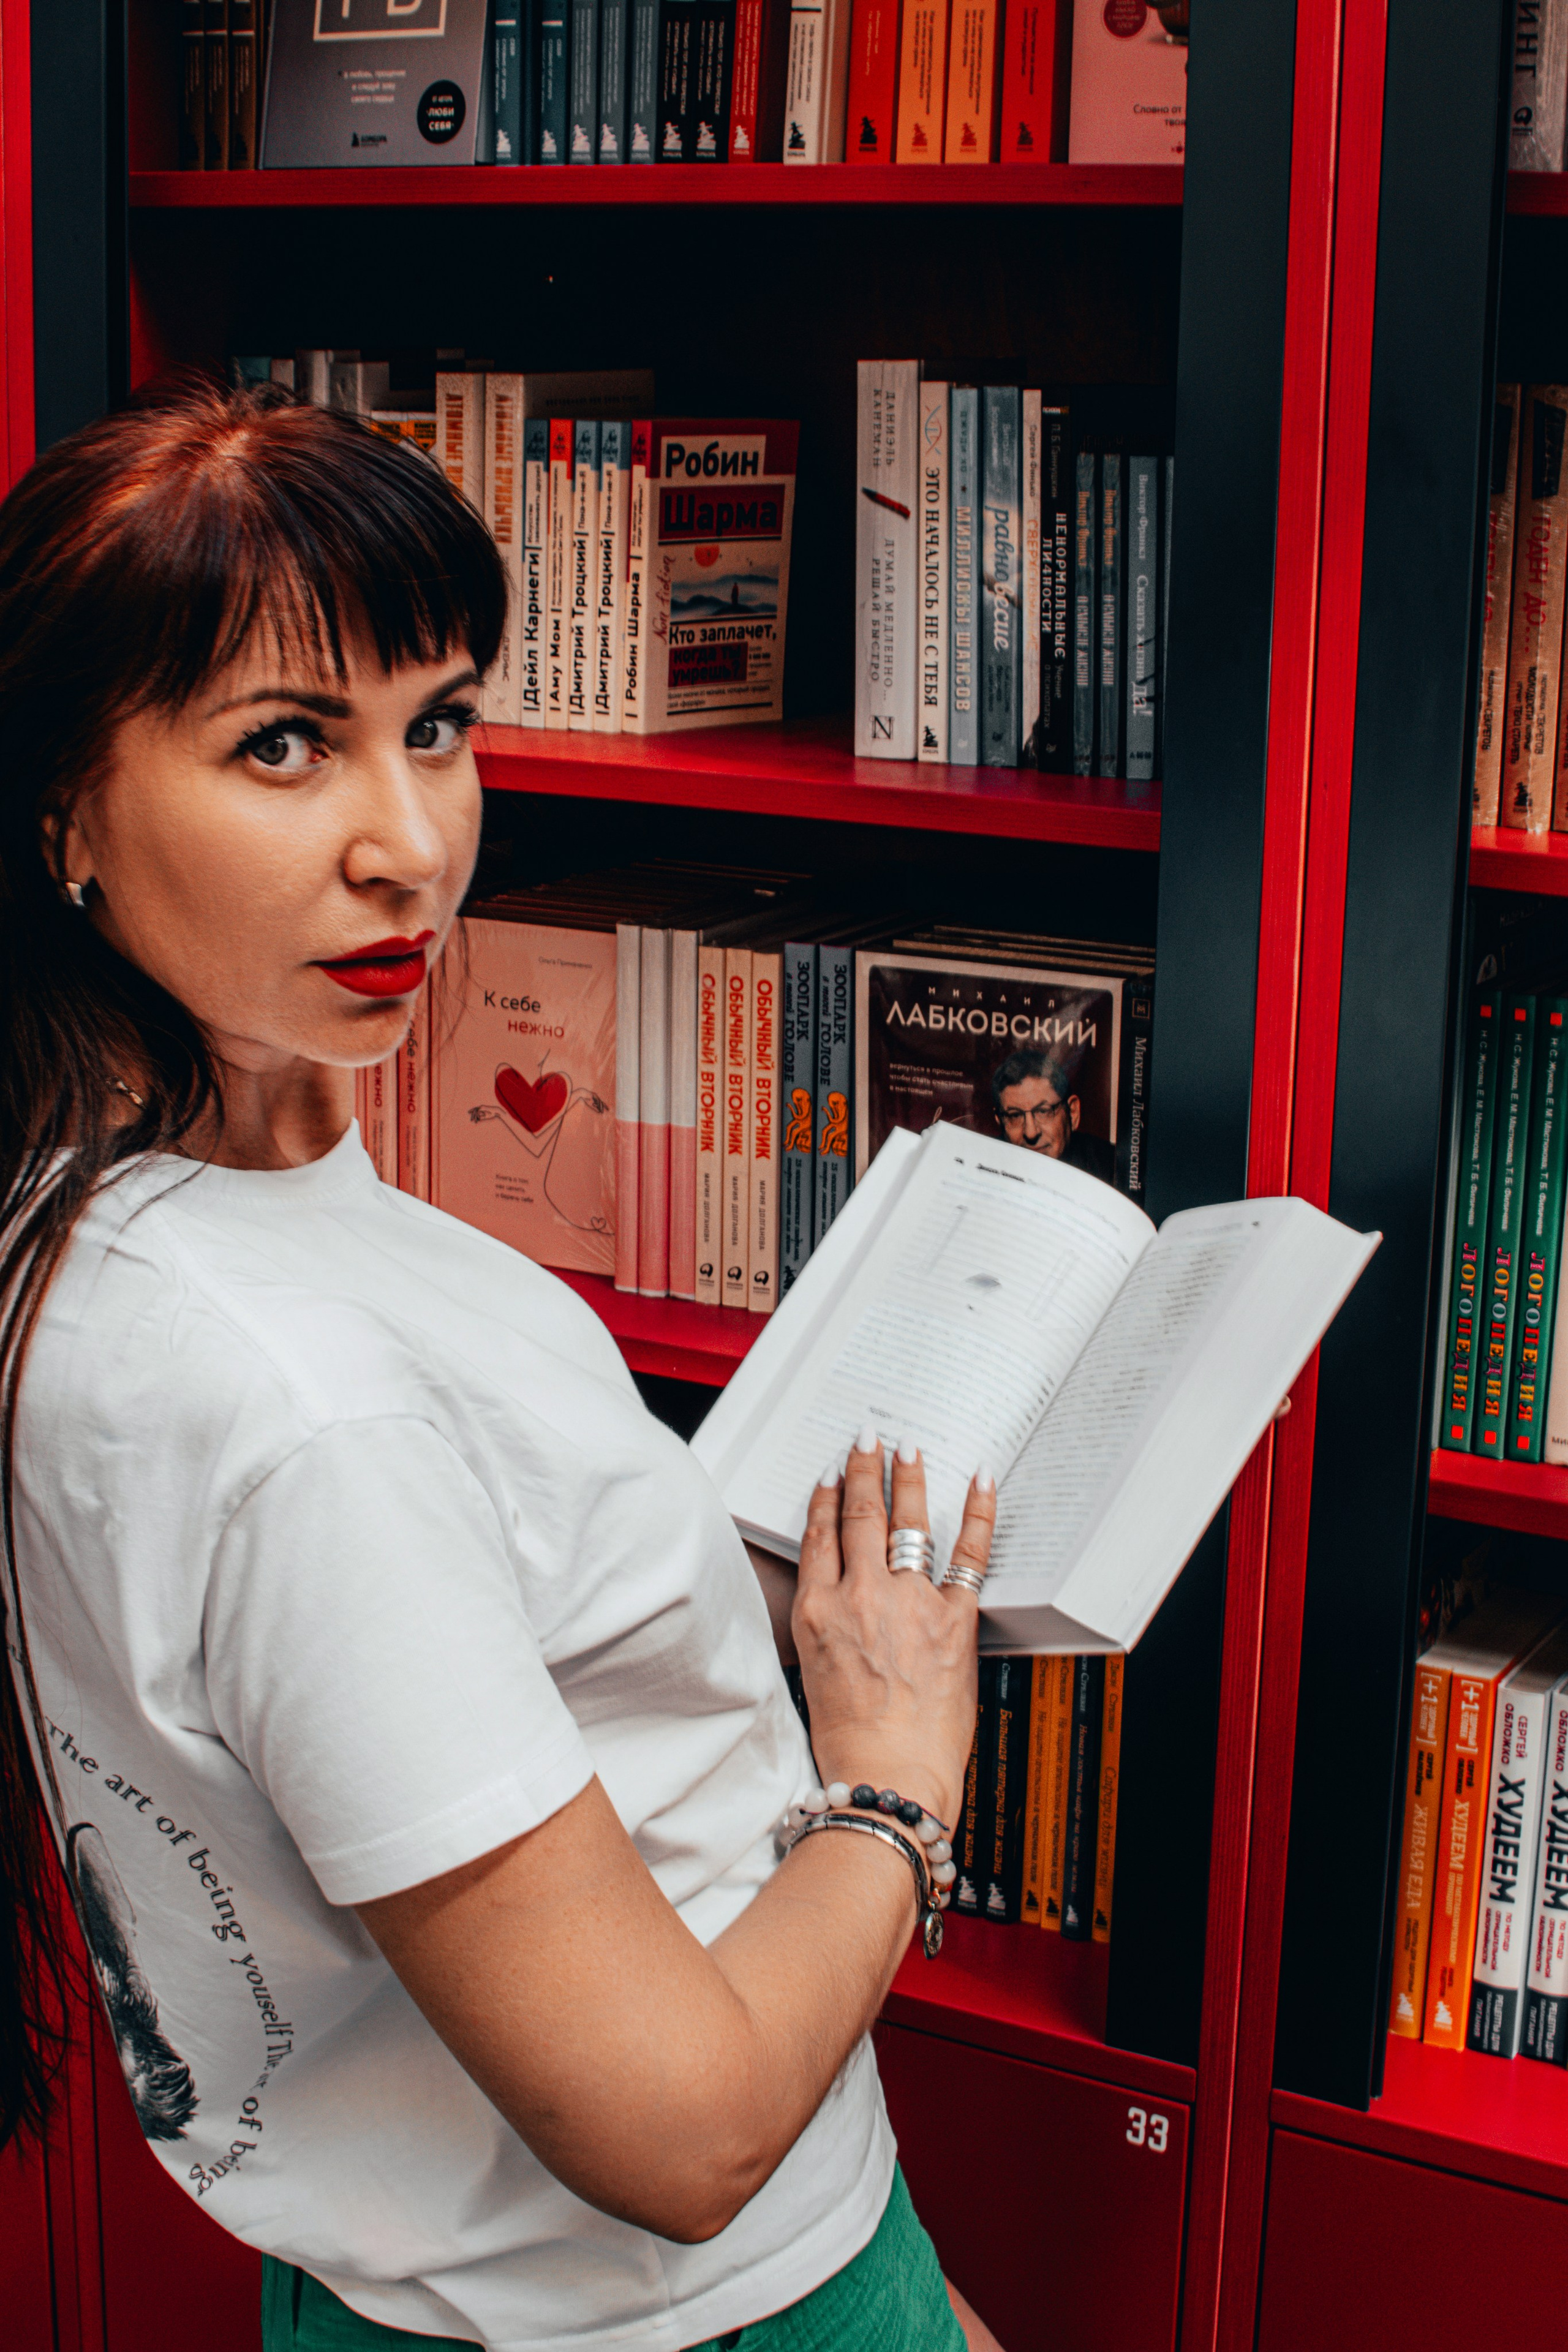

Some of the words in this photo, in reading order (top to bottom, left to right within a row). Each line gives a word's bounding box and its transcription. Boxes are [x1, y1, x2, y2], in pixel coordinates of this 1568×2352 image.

[873, 388, 882, 468] КАНЕМАН
[886, 391, 895, 466] ДАНИЭЛЬ
[665, 442, 759, 478] Робин
[925, 466, 940, 503] ЭТО
[663, 494, 777, 536] Шарма
[1137, 474, 1148, 514] Виктор
[884, 538, 895, 595] ДУМАЙ
[924, 509, 940, 609] НАЧАЛОСЬ
[955, 506, 972, 624] МИЛЛИОНЫ
[1137, 516, 1148, 560] Франкл
[1526, 516, 1551, 584] ГОДЕН
[525, 552, 542, 642] Карнеги
[571, 538, 587, 619] Троцкий
[597, 538, 614, 618] Троцкий
[628, 573, 641, 637] Шарма
[871, 558, 882, 612] РЕШАЙ
[984, 505, 1017, 652] равновесие
[1054, 513, 1067, 658] НЕНОРМАЛЬНЫЕ
[1136, 575, 1148, 631] Сказать
[549, 619, 562, 658] Мом
[669, 625, 695, 644] Кто
[700, 624, 777, 642] заплачет,
[674, 647, 717, 664] когда
[722, 645, 742, 659] ты
[871, 619, 880, 682] БЫСТРО
[924, 615, 939, 639] НЕ
[924, 644, 939, 656] С
[524, 649, 541, 704] Дейл
[549, 665, 563, 703] Аму
[570, 625, 586, 709] Дмитрий
[595, 625, 612, 709] Дмитрий
[625, 644, 638, 701] Робин
[673, 660, 741, 686] умрешь?
[924, 661, 939, 707] ТЕБЯ
[955, 631, 972, 712] ШАНСОВ
[484, 989, 496, 1008] К
[500, 995, 541, 1013] себе
[701, 973, 718, 1065] ОБЫЧНЫЙ
[729, 975, 747, 1068] ОБЫЧНЫЙ
[756, 978, 775, 1071] ОБЫЧНЫЙ
[797, 961, 810, 1041] ЗООПАРК
[834, 964, 847, 1044] ЗООПАРК
[886, 1000, 1096, 1048] ЛАБКОВСКИЙ
[928, 986, 1055, 1008] МИХАИЛ
[507, 1019, 565, 1039] нежно
[784, 1019, 795, 1083] ГОЛОВЕ
[820, 1022, 831, 1086] ГОЛОВЕ
[407, 1061, 416, 1114] нежно
[889, 1063, 925, 1072] вернуться
[932, 1068, 963, 1077] прошлое
[1133, 1036, 1147, 1096] Михаил
[700, 1071, 715, 1153] ВТОРНИК
[728, 1073, 744, 1156] ВТОРНИК
[755, 1077, 772, 1160] ВТОРНИК
[1129, 1098, 1145, 1191] Лабковский
[1451, 1242, 1477, 1412] ЛОГОПЕДИЯ
[1484, 1246, 1512, 1418] ЛОГОПЕДИЯ
[1517, 1251, 1545, 1423] ЛОГОПЕДИЯ
[998, 1708, 1012, 1761] Большая
[1077, 1724, 1088, 1754] Новая
[1501, 1703, 1515, 1765] ОБЛОЖКО
[1515, 1716, 1528, 1758] СЕРГЕЙ
[1555, 1709, 1568, 1772] ОБЛОЖКО
[965, 1756, 978, 1807] пятерка
[995, 1762, 1008, 1813] пятерка
[965, 1808, 978, 1830] для
[994, 1815, 1006, 1837] для
[1409, 1803, 1429, 1870] ЖИВАЯ
[1449, 1798, 1470, 1870] ХУДЕЕМ
[1488, 1772, 1526, 1904] ХУДЕЕМ
[964, 1831, 974, 1868] жизни
[993, 1838, 1003, 1874] жизни
[104, 1774, 154, 1813] art
[155, 1815, 197, 1846] of
[187, 1847, 246, 1943] being
[228, 1953, 294, 2036] youself
[1408, 1874, 1423, 1909] ЕДА
[238, 2096, 263, 2132] of
[1126, 2106, 1169, 2154] 33
